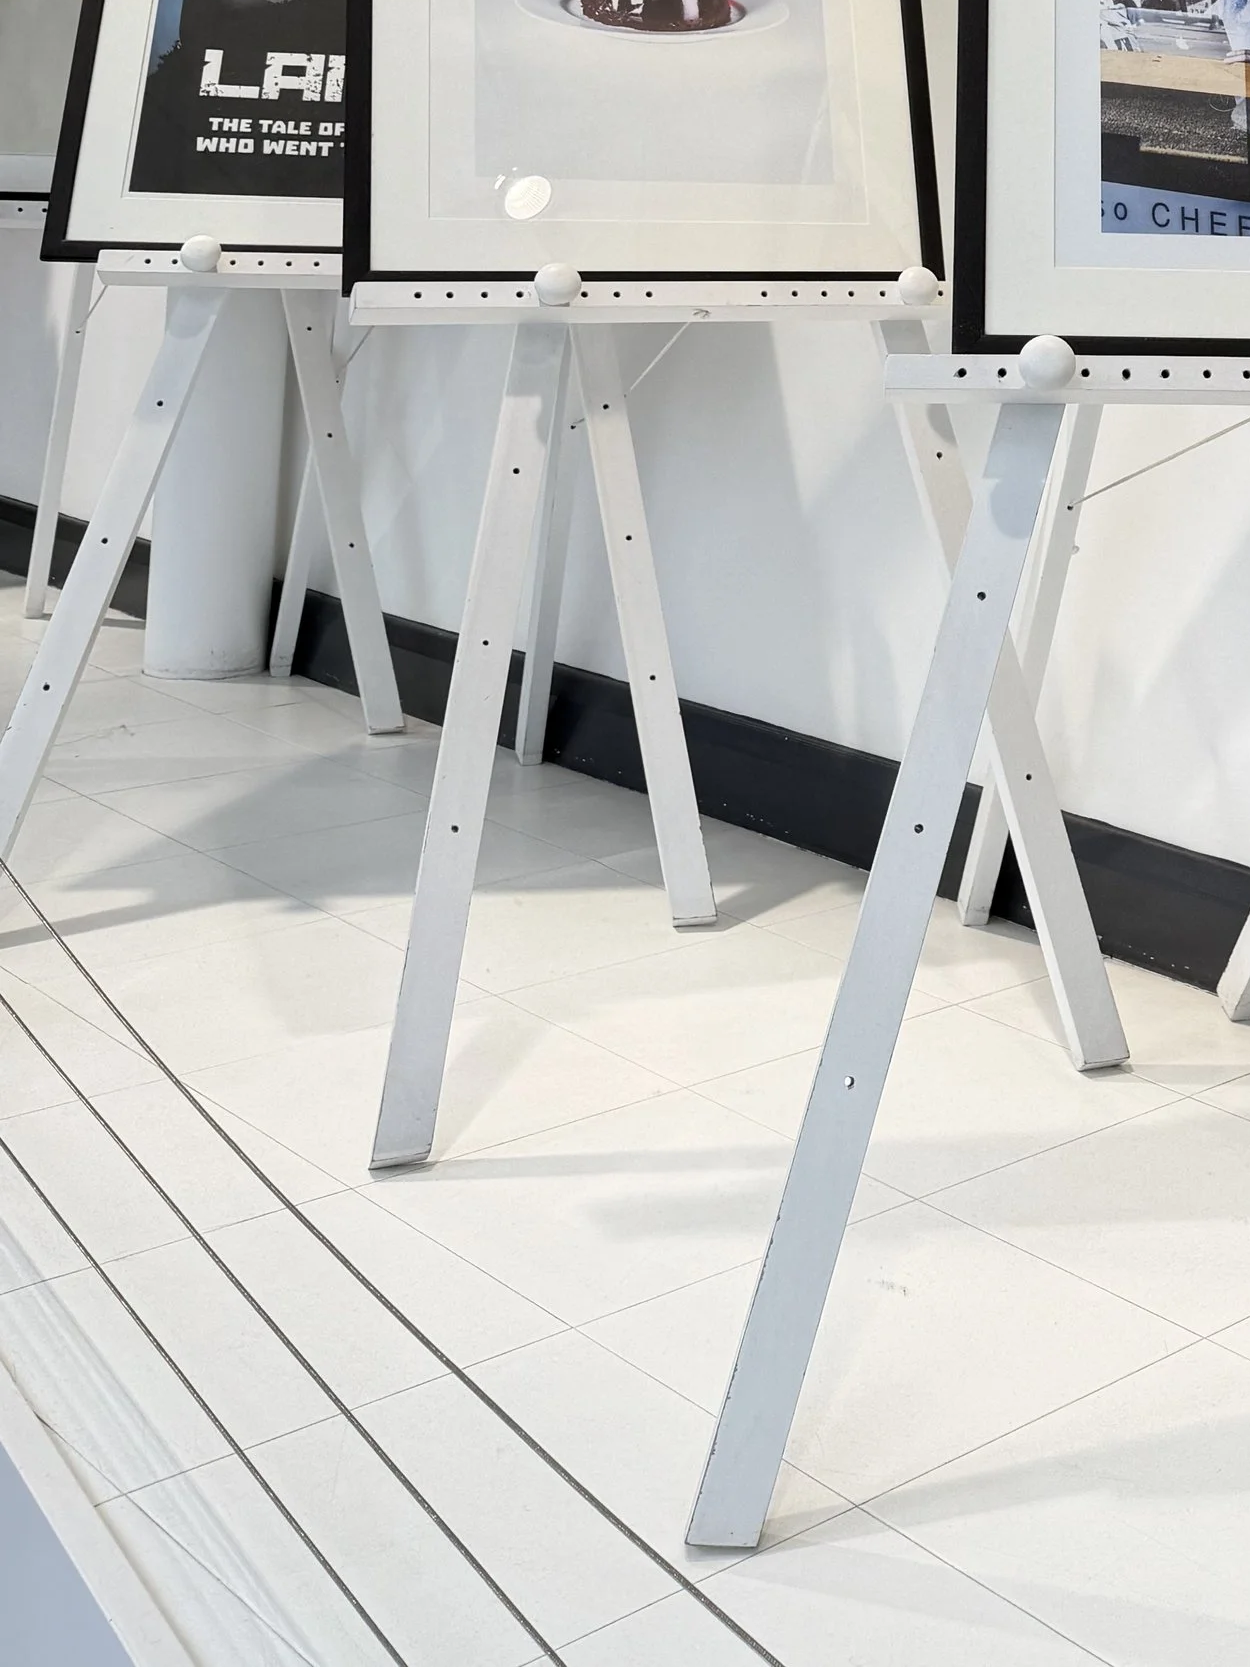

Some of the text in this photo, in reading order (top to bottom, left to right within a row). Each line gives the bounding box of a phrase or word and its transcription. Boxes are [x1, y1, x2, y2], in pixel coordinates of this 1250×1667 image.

[208, 117, 345, 137] THE TALE OF
[196, 136, 255, 154] WHO
[262, 139, 334, 157] WENT
